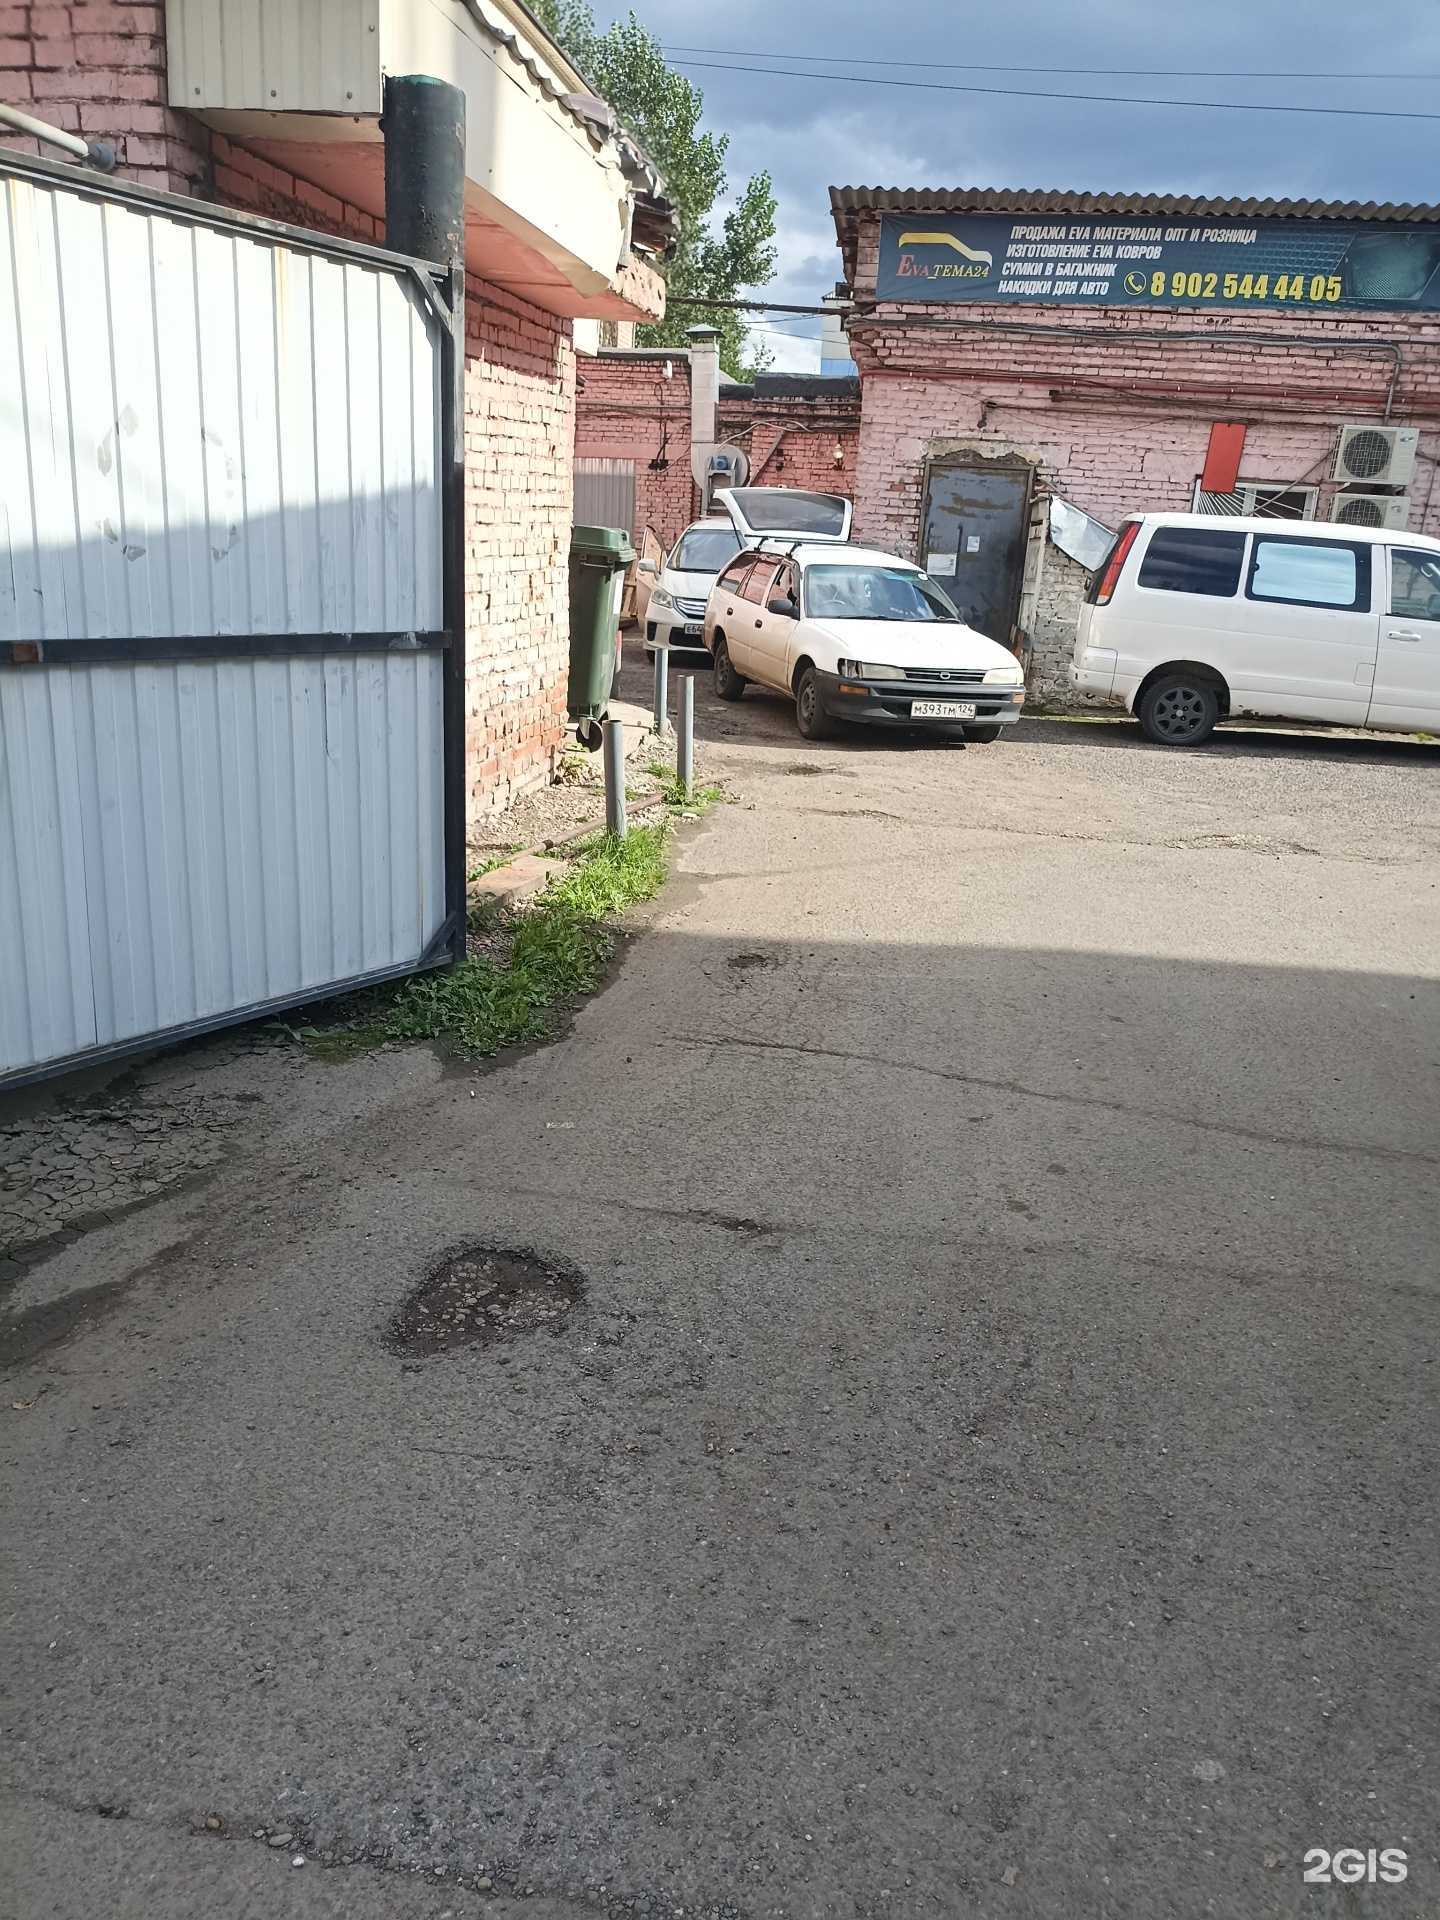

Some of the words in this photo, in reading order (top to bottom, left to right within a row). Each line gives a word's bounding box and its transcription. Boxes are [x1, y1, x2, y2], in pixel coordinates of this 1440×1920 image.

[1010, 226, 1066, 240] ПРОДАЖА
[1068, 227, 1091, 240] EVA
[1092, 226, 1162, 241] МАТЕРИАЛА
[1164, 228, 1188, 242] ОПТ
[1189, 229, 1200, 242] И
[1201, 228, 1257, 244] РОЗНИЦА
[1006, 244, 1092, 258] ИЗГОТОВЛЕНИЕ
[1094, 245, 1114, 258] EVA
[1115, 245, 1162, 260] КОВРОВ
[1002, 262, 1044, 276] СУМКИ
[1045, 263, 1053, 275] В
[1055, 262, 1117, 278] БАГАЖНИК
[998, 280, 1051, 294] НАКИДКИ
[1052, 281, 1077, 295] ДЛЯ
[1079, 281, 1110, 296] АВТО
[1150, 271, 1166, 296] 8
[1171, 271, 1218, 298] 902
[1223, 272, 1269, 299] 544
[1273, 273, 1304, 300] 44
[1309, 275, 1342, 301] 05
